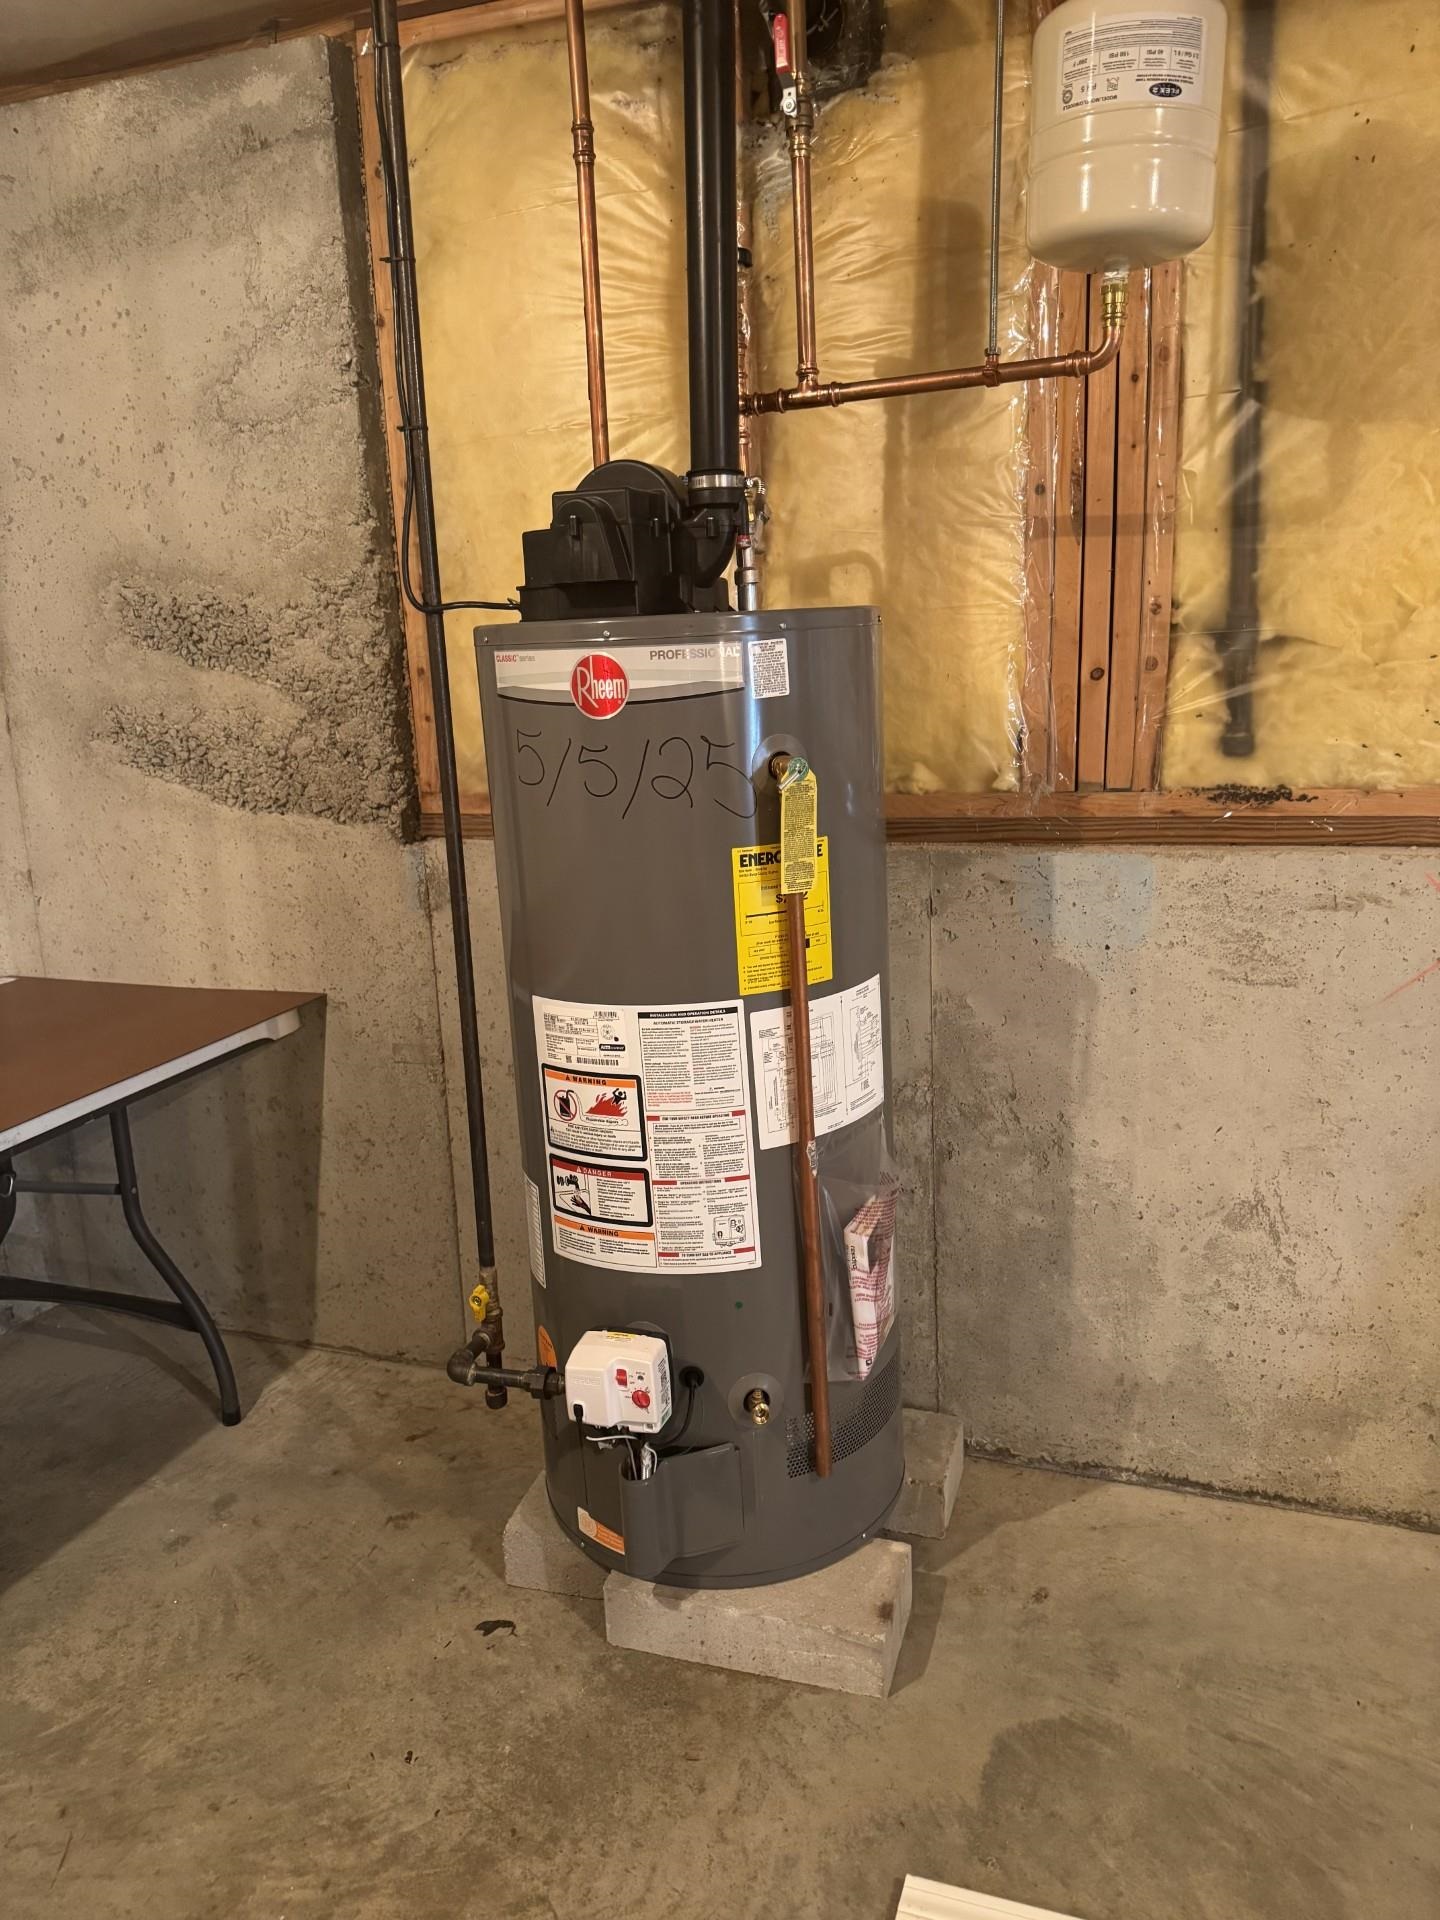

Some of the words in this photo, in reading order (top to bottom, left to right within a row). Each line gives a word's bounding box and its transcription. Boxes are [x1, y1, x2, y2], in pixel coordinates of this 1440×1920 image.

[576, 655, 626, 709] Rheem
[515, 727, 758, 820] 5/5/25
[572, 1076, 608, 1086] WARNING
[583, 1168, 613, 1178] DANGER
[588, 1226, 619, 1237] WARNING
